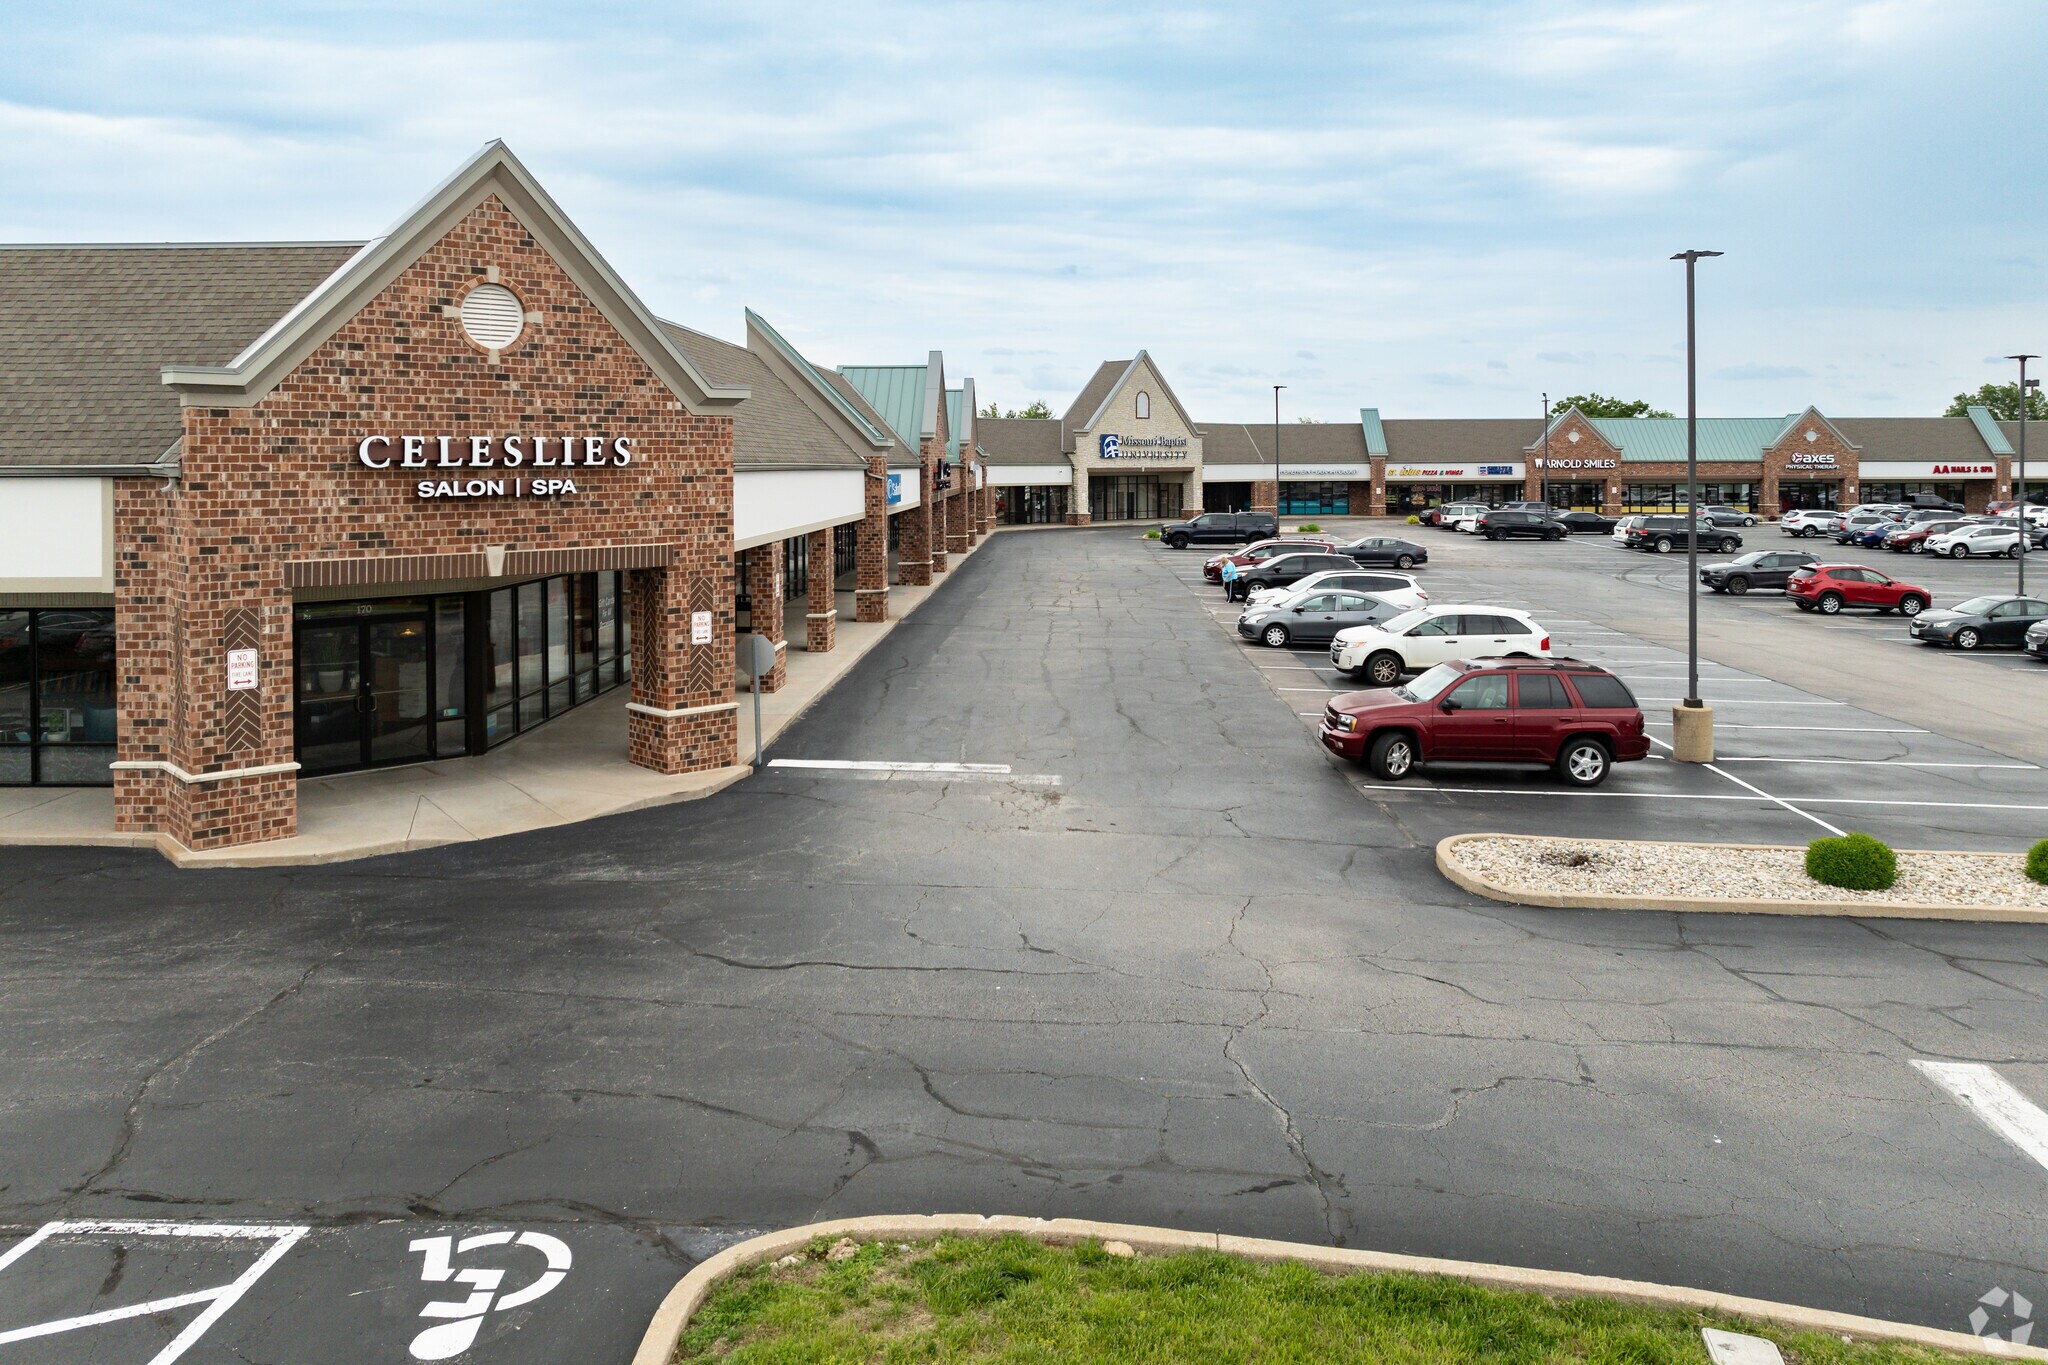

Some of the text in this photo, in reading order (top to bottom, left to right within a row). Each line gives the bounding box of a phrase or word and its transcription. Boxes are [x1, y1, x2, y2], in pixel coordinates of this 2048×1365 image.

[1120, 435, 1187, 448] Missouri Baptist
[358, 435, 631, 469] CELESLIES
[1121, 450, 1187, 459] UNIVERSITY
[1802, 454, 1835, 463] axes
[1546, 459, 1616, 468] ARNOLD SMILES
[1933, 465, 1949, 474] AA
[417, 479, 504, 498] SALON
[531, 479, 578, 495] SPA
[356, 604, 373, 614] 170
[231, 661, 255, 669] PARKING
